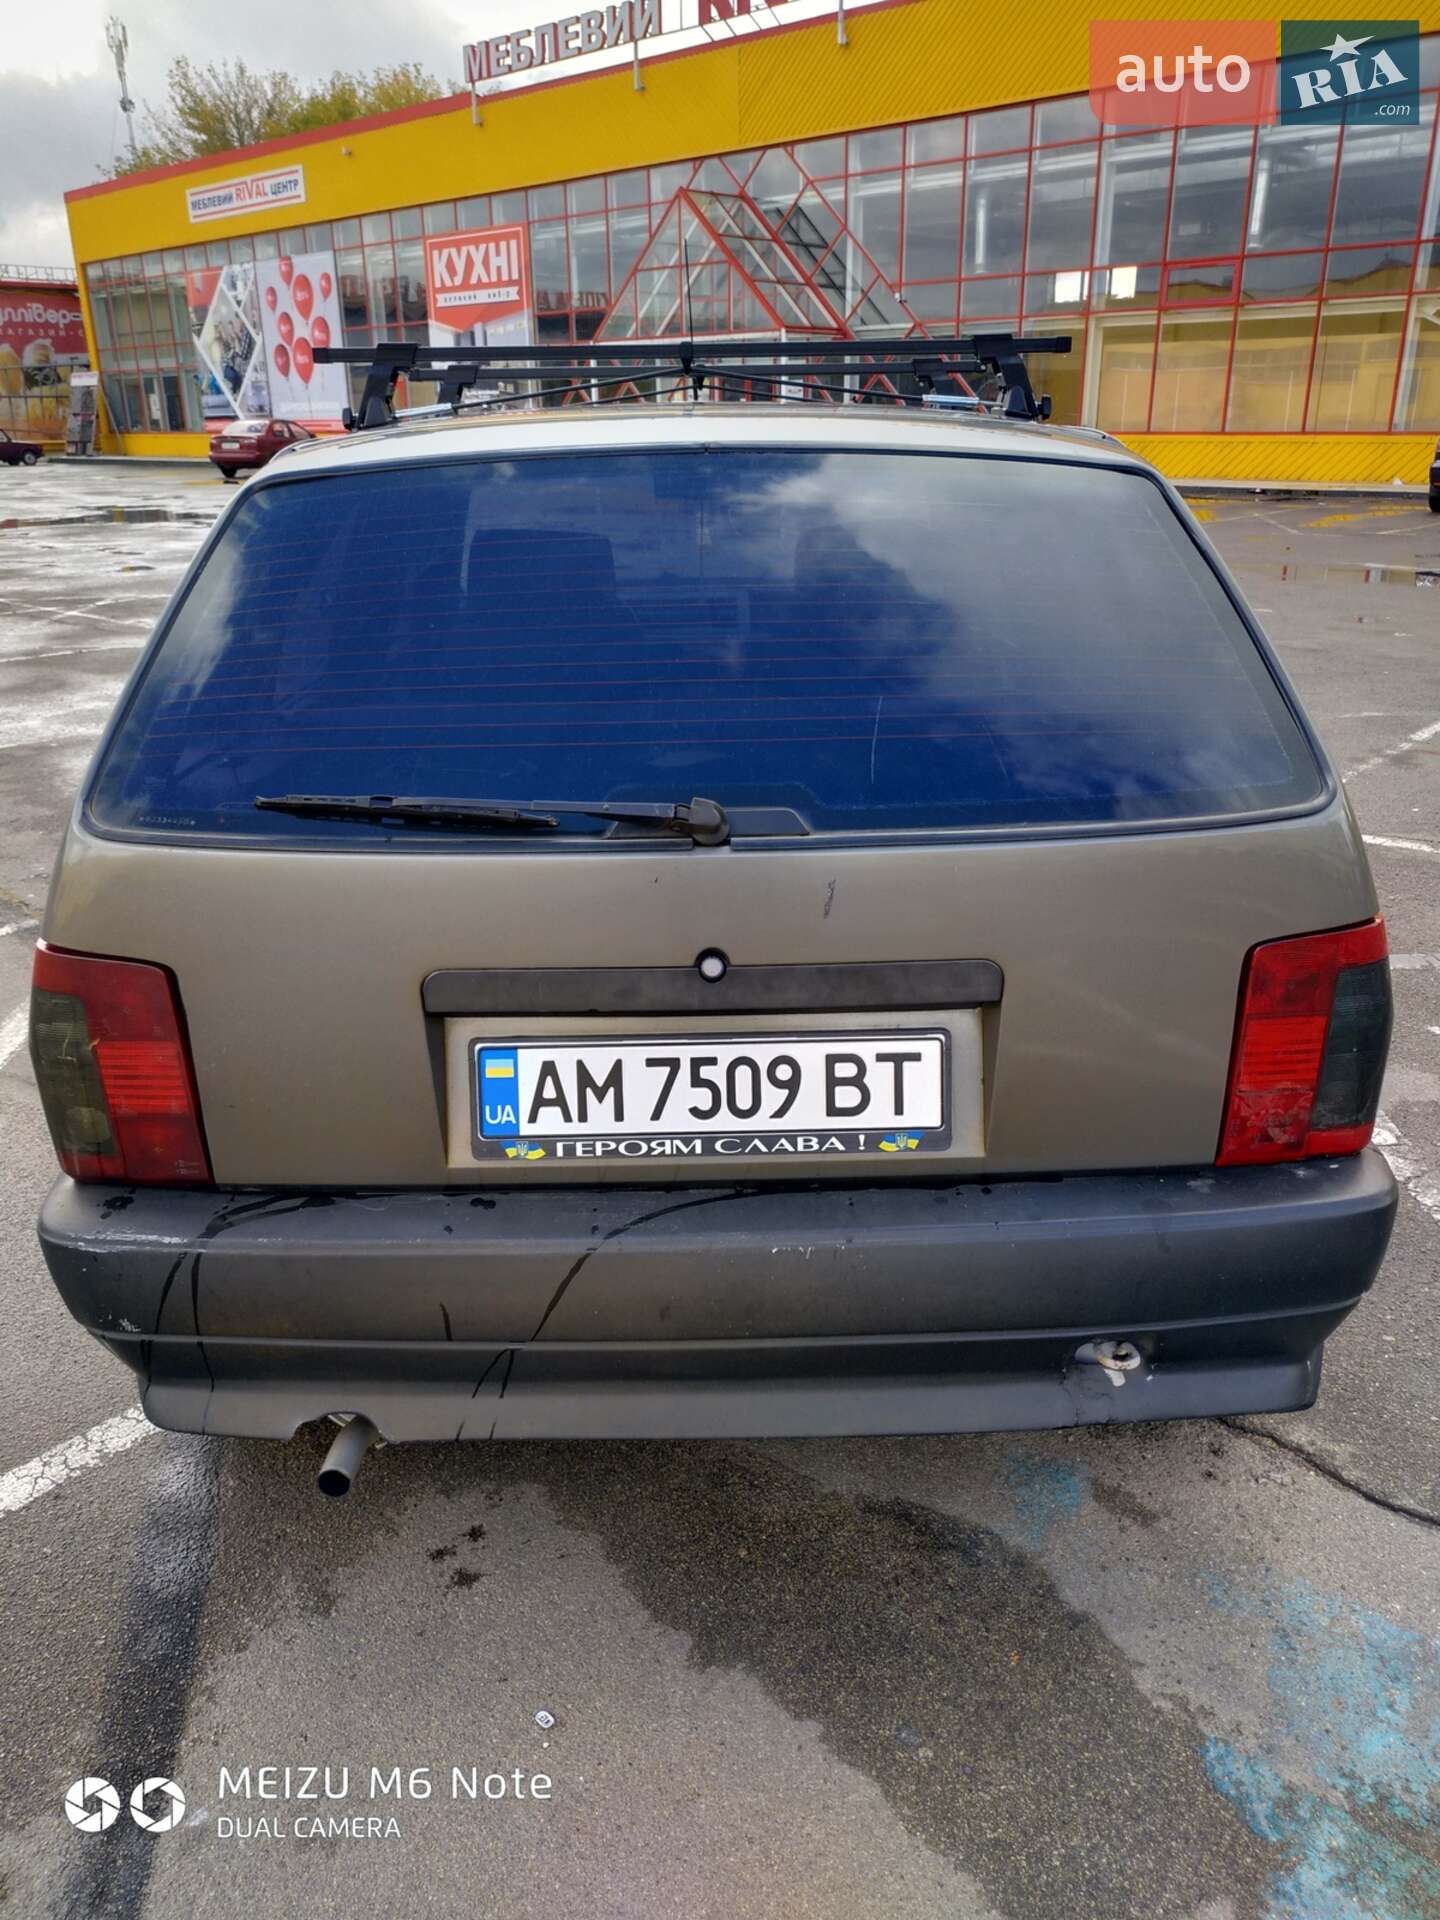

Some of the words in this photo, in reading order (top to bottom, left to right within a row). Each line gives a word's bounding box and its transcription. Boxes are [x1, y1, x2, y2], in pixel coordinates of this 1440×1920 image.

[270, 178, 299, 196] ЦЕНТР
[432, 239, 519, 288] КУХНІ
[527, 1058, 624, 1124] AM
[645, 1054, 802, 1121] 7509
[825, 1052, 922, 1117] BT
[485, 1104, 516, 1124] UA
[556, 1140, 702, 1158] ГЕРОЯМ
[714, 1137, 846, 1154] СЛАВА
